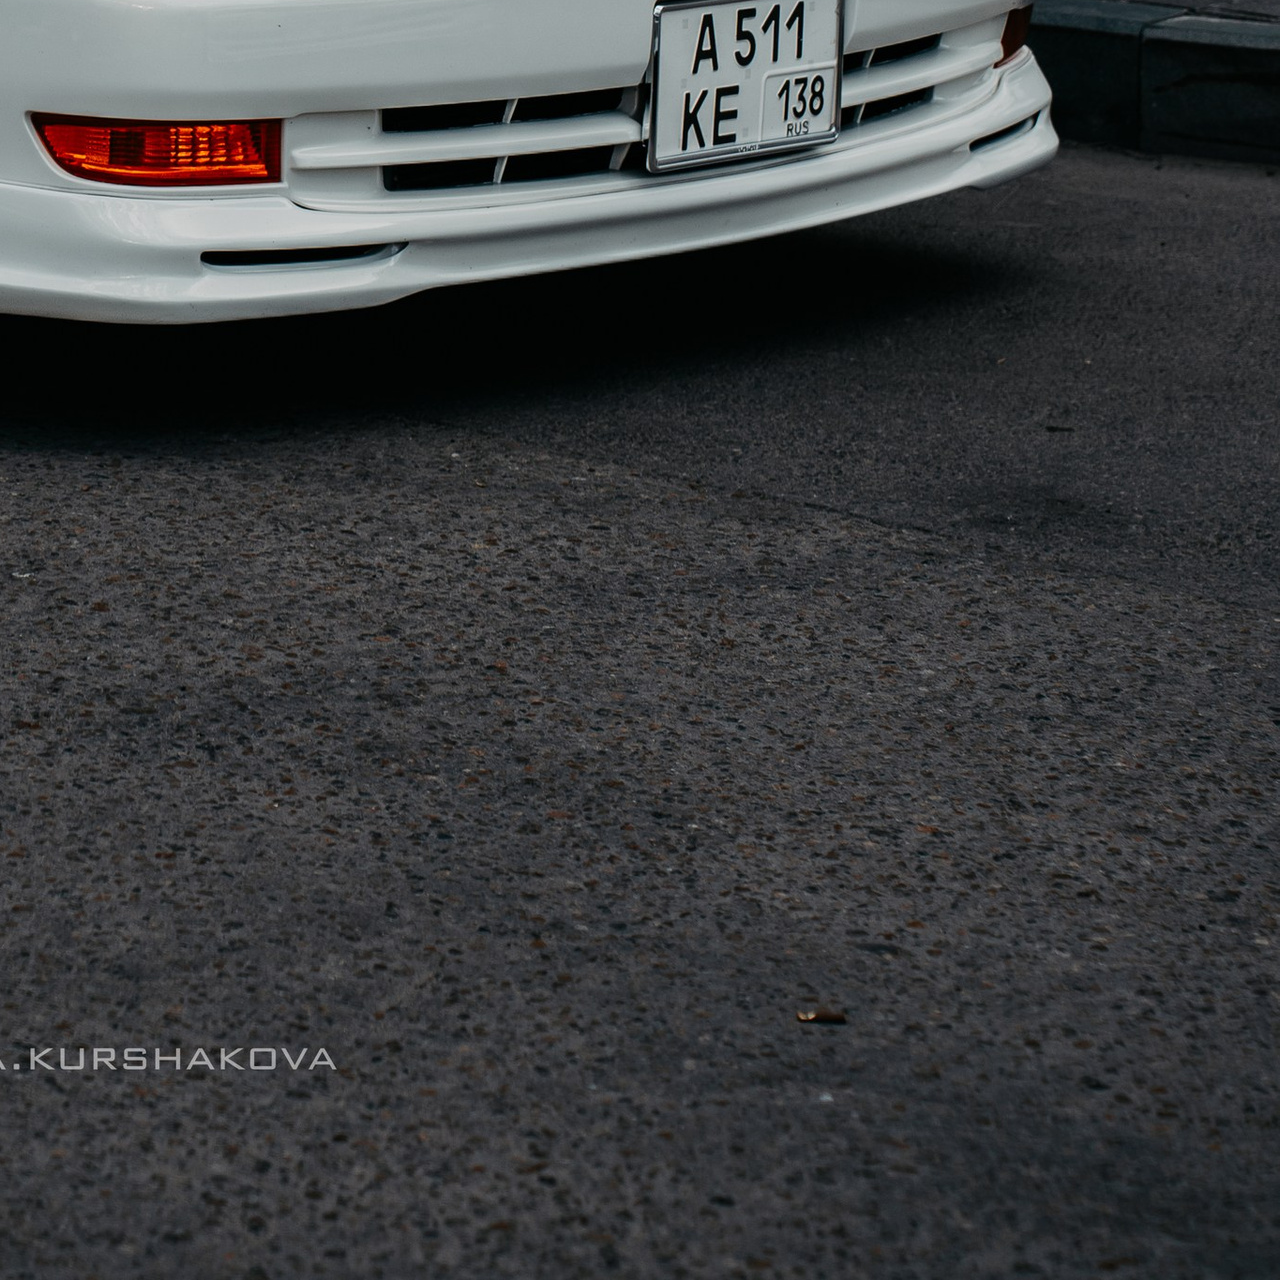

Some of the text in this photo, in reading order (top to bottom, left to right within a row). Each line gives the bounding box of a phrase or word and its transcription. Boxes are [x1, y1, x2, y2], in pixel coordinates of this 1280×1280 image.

[691, 0, 805, 75] A 511
[681, 74, 825, 152] KE 138
[787, 122, 810, 137] RUS
